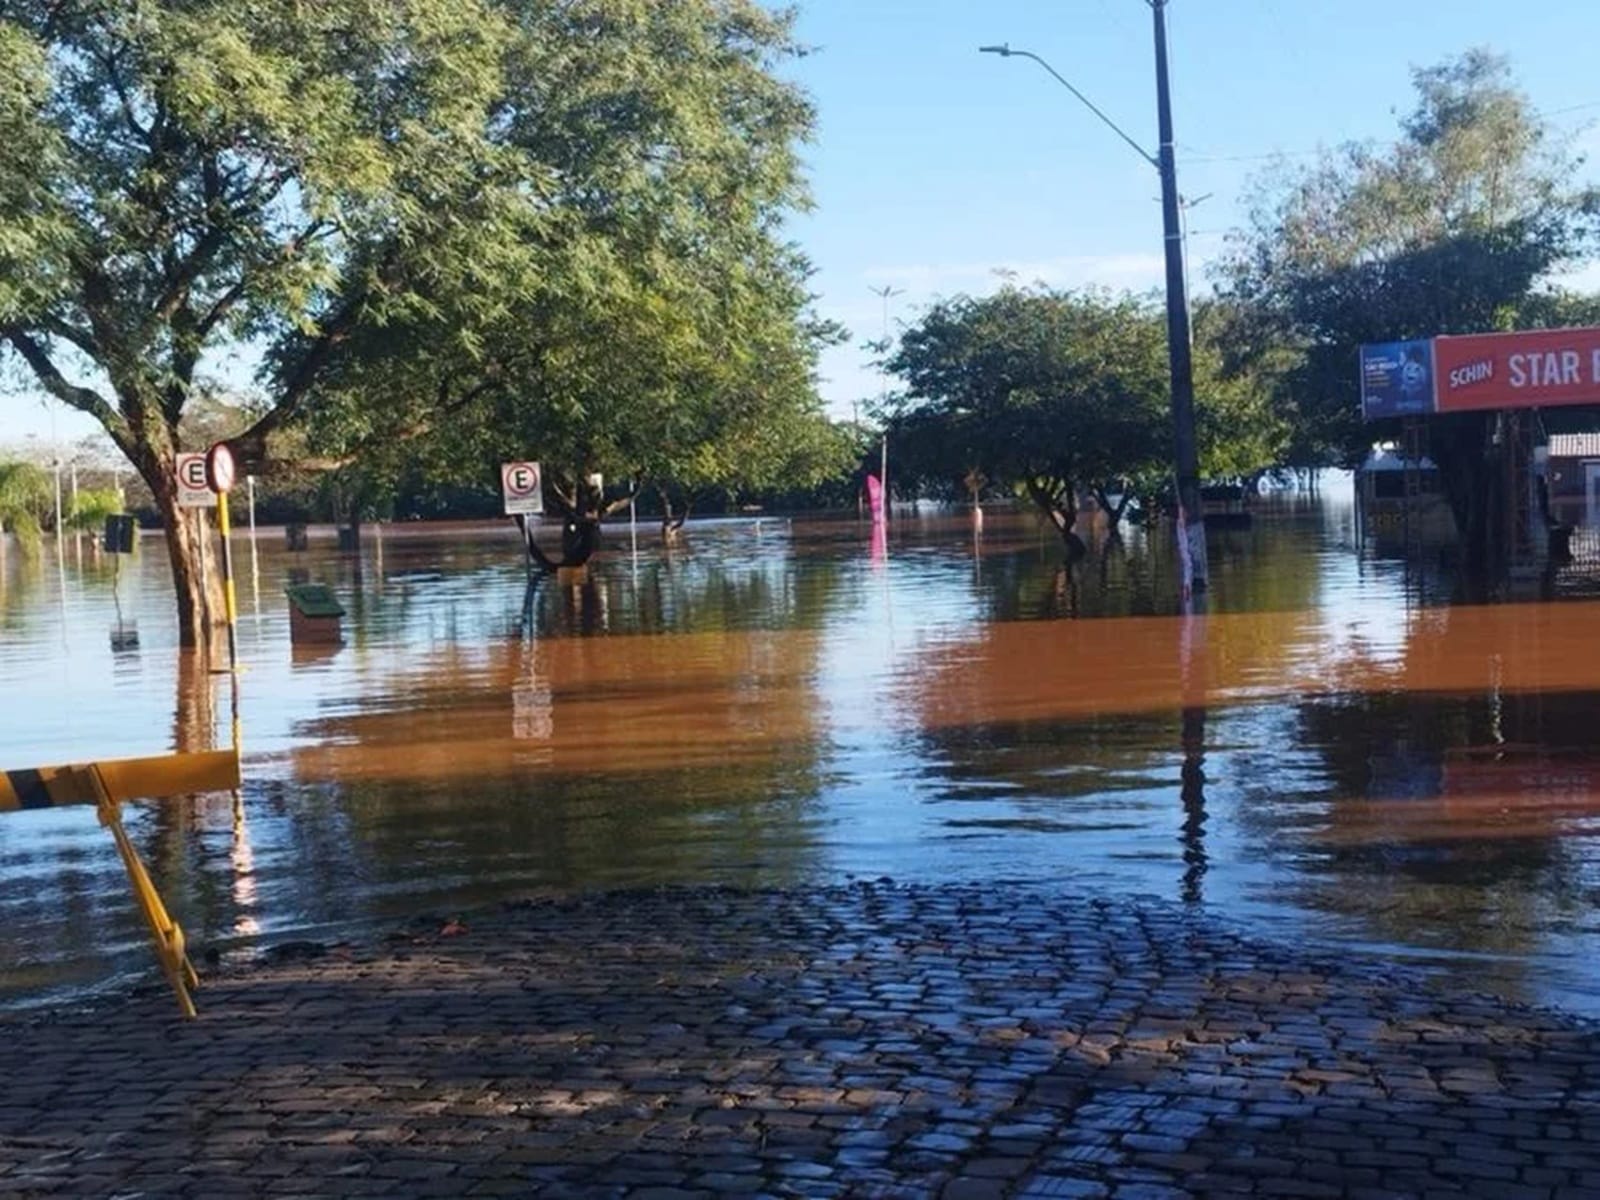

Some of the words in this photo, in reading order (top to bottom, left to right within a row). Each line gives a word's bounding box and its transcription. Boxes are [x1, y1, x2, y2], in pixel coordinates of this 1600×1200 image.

[1451, 362, 1492, 387] SCHIN
[1510, 352, 1580, 386] STAR
[189, 463, 204, 484] E
[515, 470, 528, 489] E
